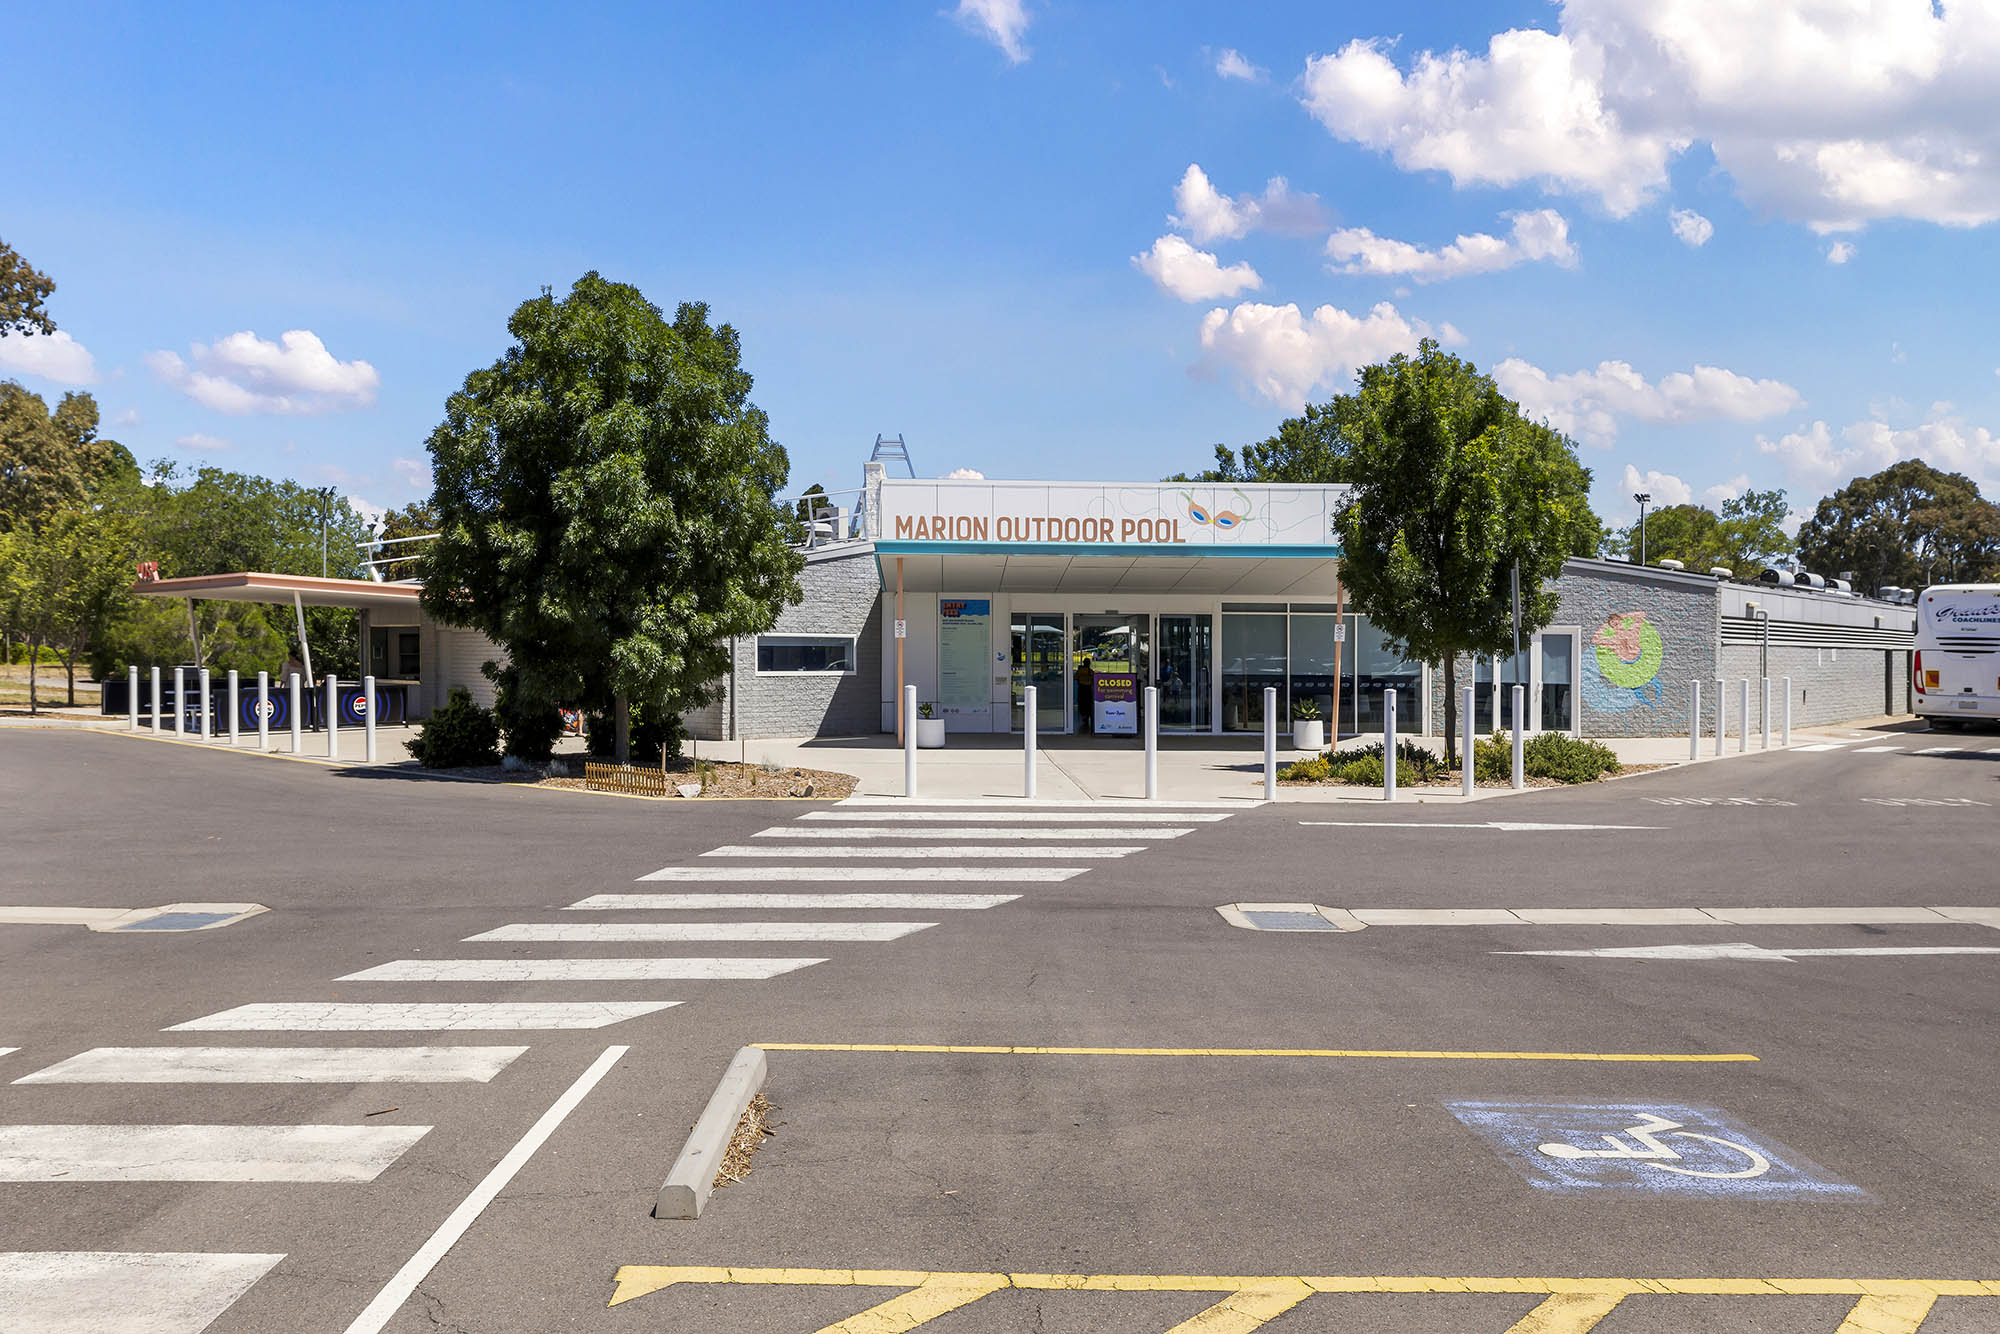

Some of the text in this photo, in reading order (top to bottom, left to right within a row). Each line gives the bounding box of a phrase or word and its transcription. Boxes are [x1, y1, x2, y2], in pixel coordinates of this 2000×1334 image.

[895, 515, 1186, 543] MARION OUTDOOR POOL
[1098, 679, 1132, 687] CLOSED
